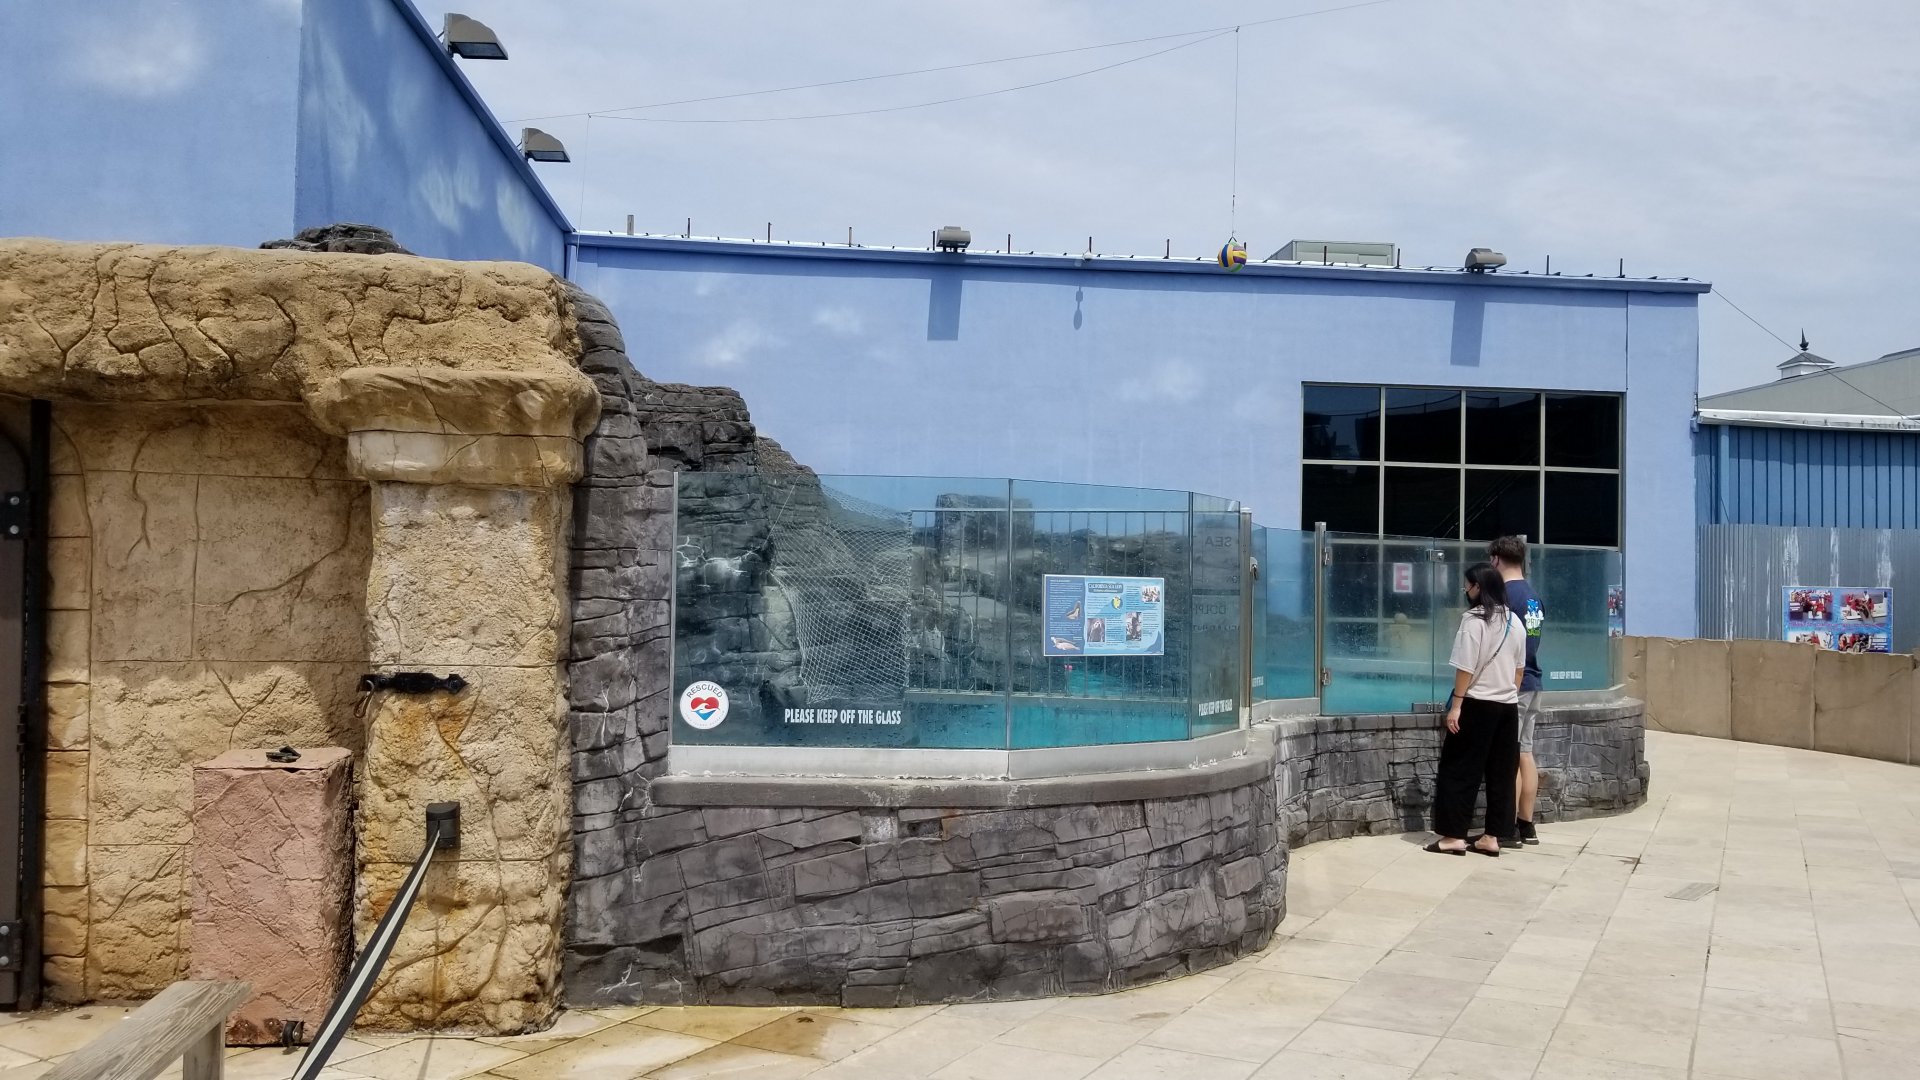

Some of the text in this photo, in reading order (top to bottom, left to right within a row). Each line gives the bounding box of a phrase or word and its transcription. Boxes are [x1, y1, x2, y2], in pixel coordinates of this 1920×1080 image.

[1396, 564, 1410, 591] E
[686, 684, 723, 698] RESCUED
[784, 708, 902, 725] PLEASE KEEP OFF THE GLASS
